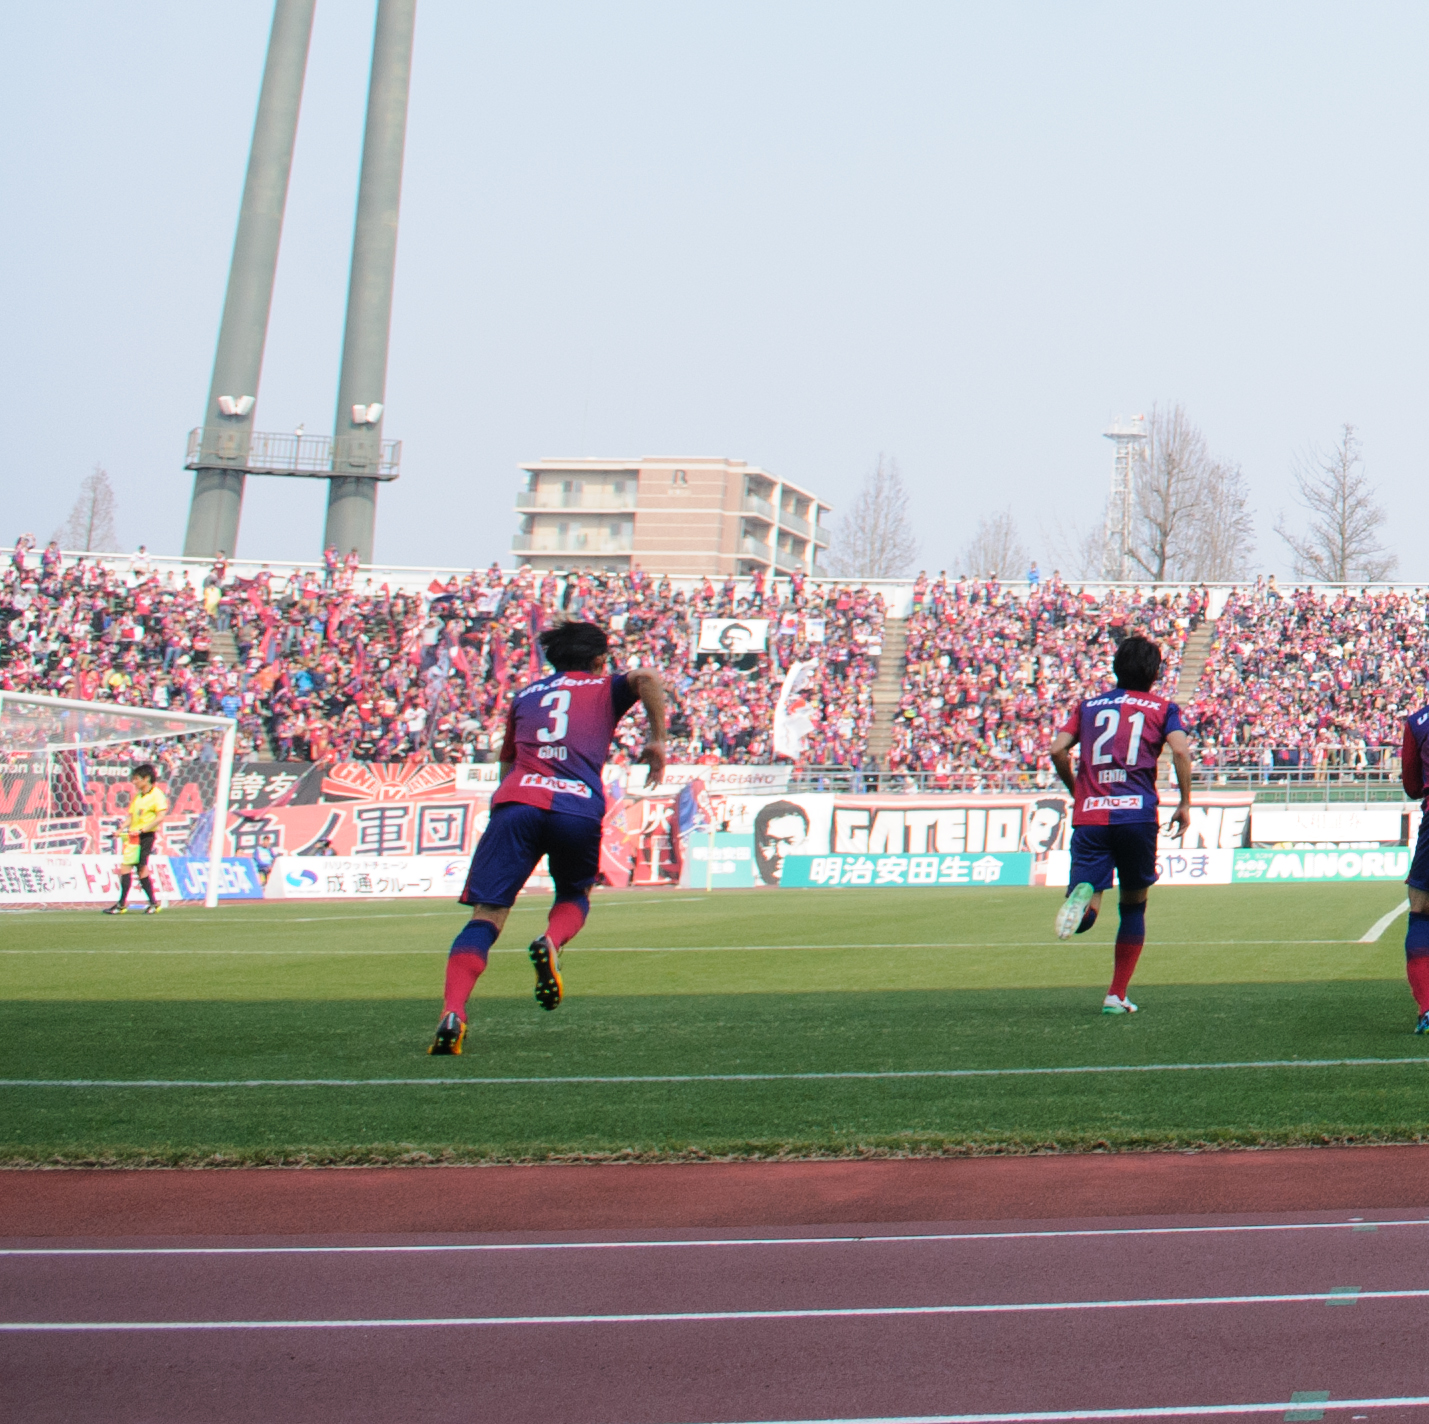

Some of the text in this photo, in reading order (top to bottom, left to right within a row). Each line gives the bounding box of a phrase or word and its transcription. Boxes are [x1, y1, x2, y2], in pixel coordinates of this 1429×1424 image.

[536, 689, 571, 743] 3
[1086, 694, 1161, 711] un.deux
[1092, 708, 1145, 766] 21
[809, 855, 1004, 885] 明治安田生命
[1266, 851, 1410, 879] MINORU
[326, 872, 434, 894] 成通グループ
